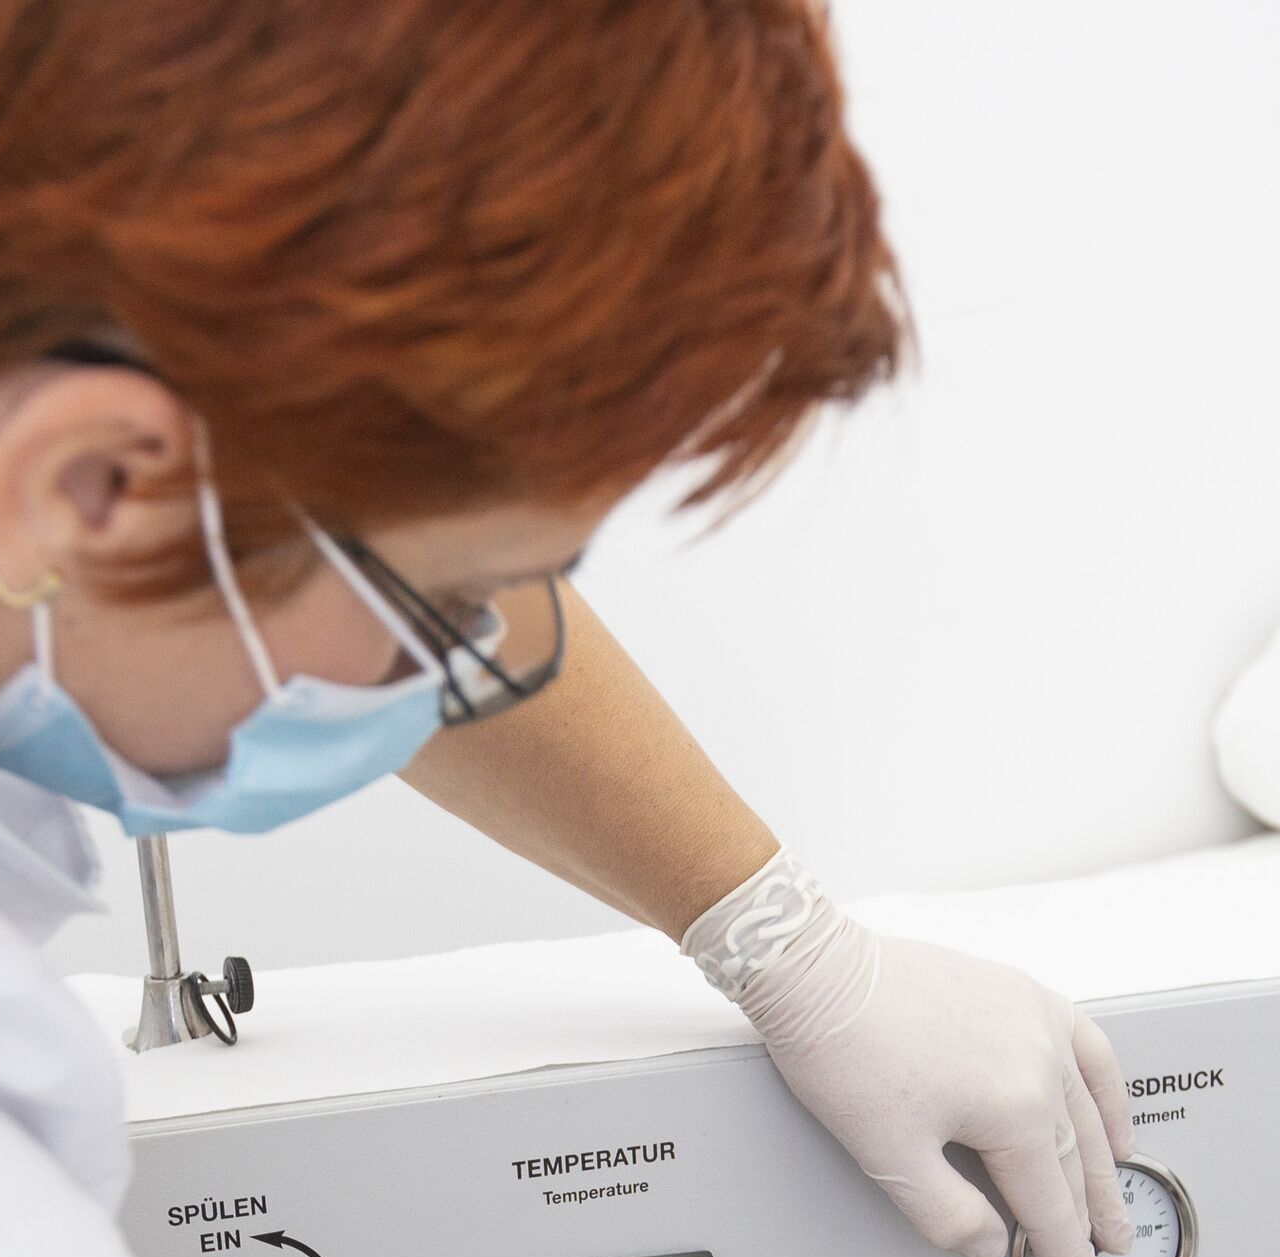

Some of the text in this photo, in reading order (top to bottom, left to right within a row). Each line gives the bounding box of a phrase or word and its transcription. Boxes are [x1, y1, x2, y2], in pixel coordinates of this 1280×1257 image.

[1125, 1068, 1224, 1099] SDRUCK
[1132, 1106, 1186, 1126] atment
[511, 1141, 676, 1180] TEMPERATUR
[542, 1181, 650, 1205] Temperature
[1123, 1191, 1134, 1205] 50
[167, 1195, 268, 1226] SPÜLEN
[200, 1229, 242, 1253] EIN
[1135, 1224, 1153, 1239] 200
